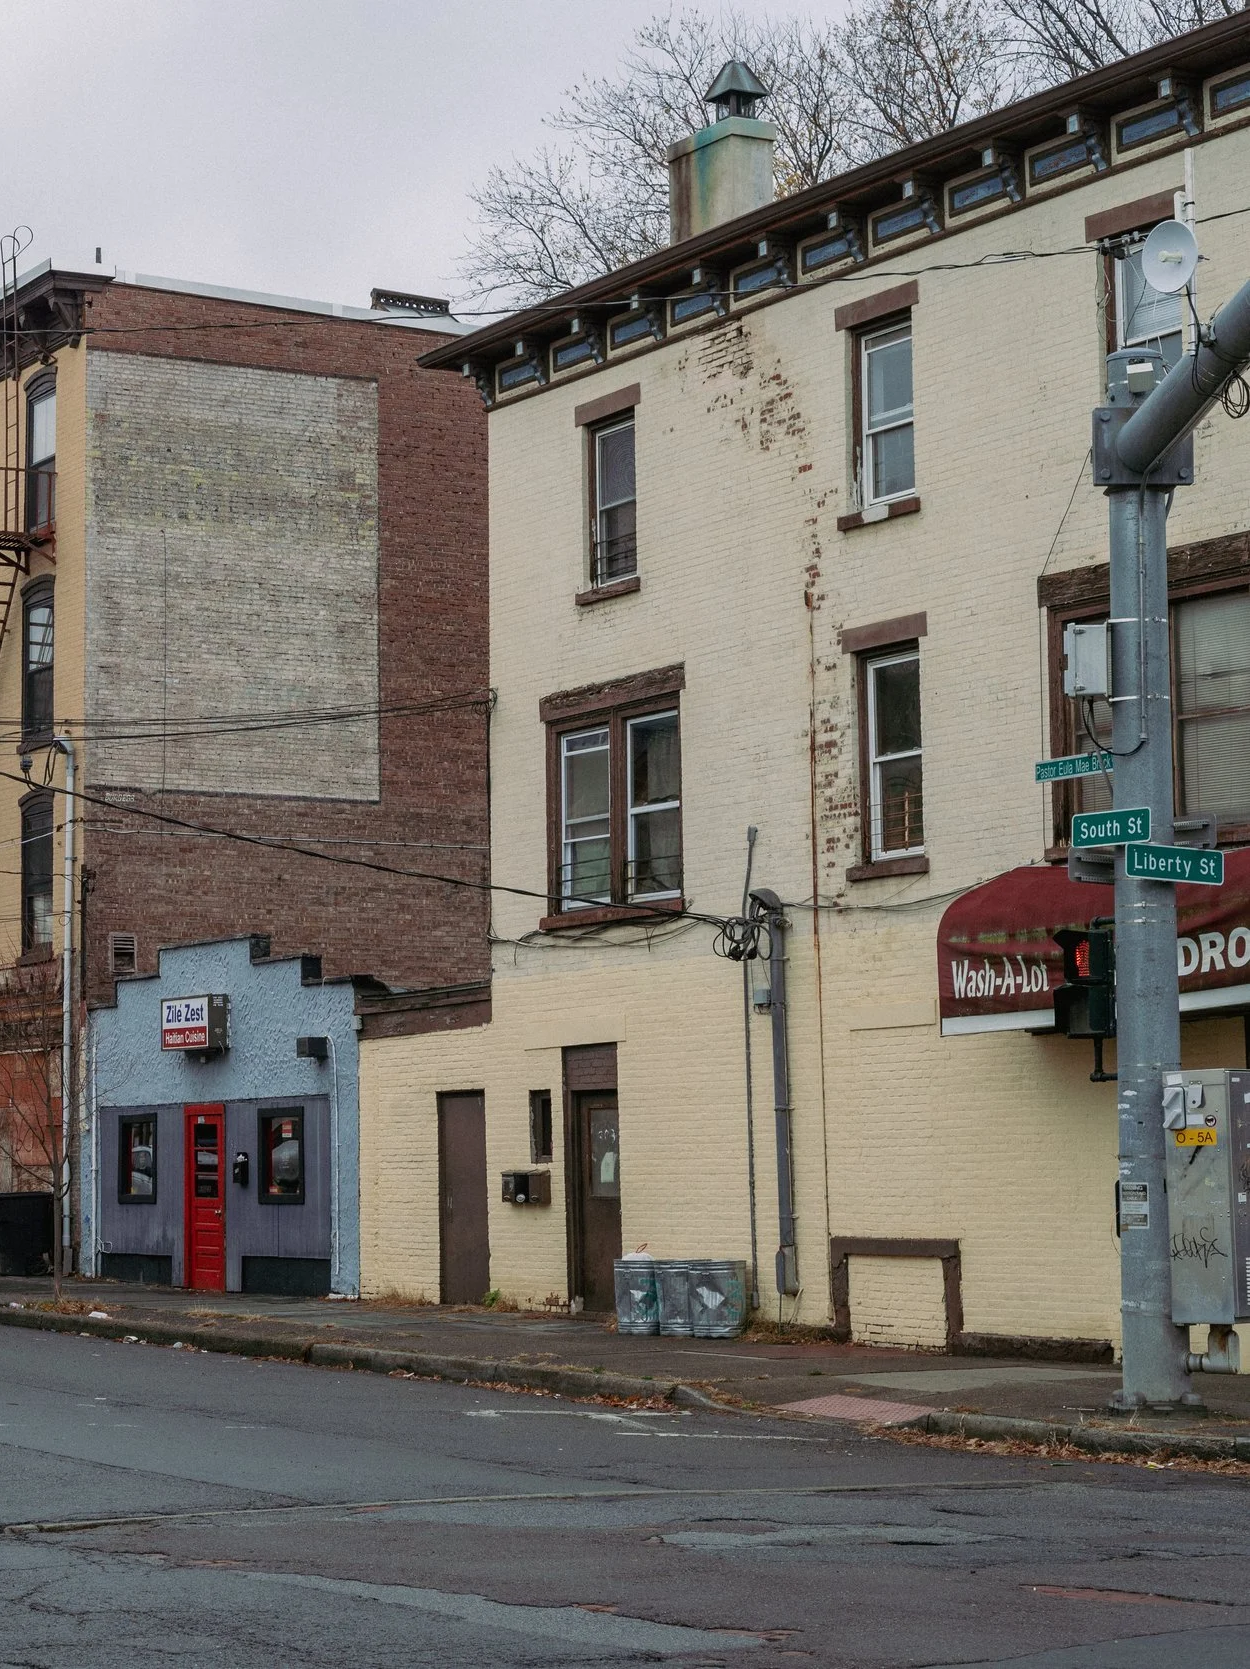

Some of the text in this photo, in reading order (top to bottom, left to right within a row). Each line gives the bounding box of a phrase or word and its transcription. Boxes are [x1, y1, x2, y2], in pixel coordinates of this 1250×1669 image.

[1036, 754, 1111, 779] Pastor Eula Mae Brck
[1080, 817, 1142, 839] South St
[1134, 851, 1215, 878] Liberty St
[1177, 926, 1250, 976] DRO
[951, 955, 1050, 999] Wash-A-Lot
[166, 1003, 204, 1023] Zilé Zest
[184, 1030, 205, 1043] Cuisine
[1197, 1131, 1213, 1143] 5A
